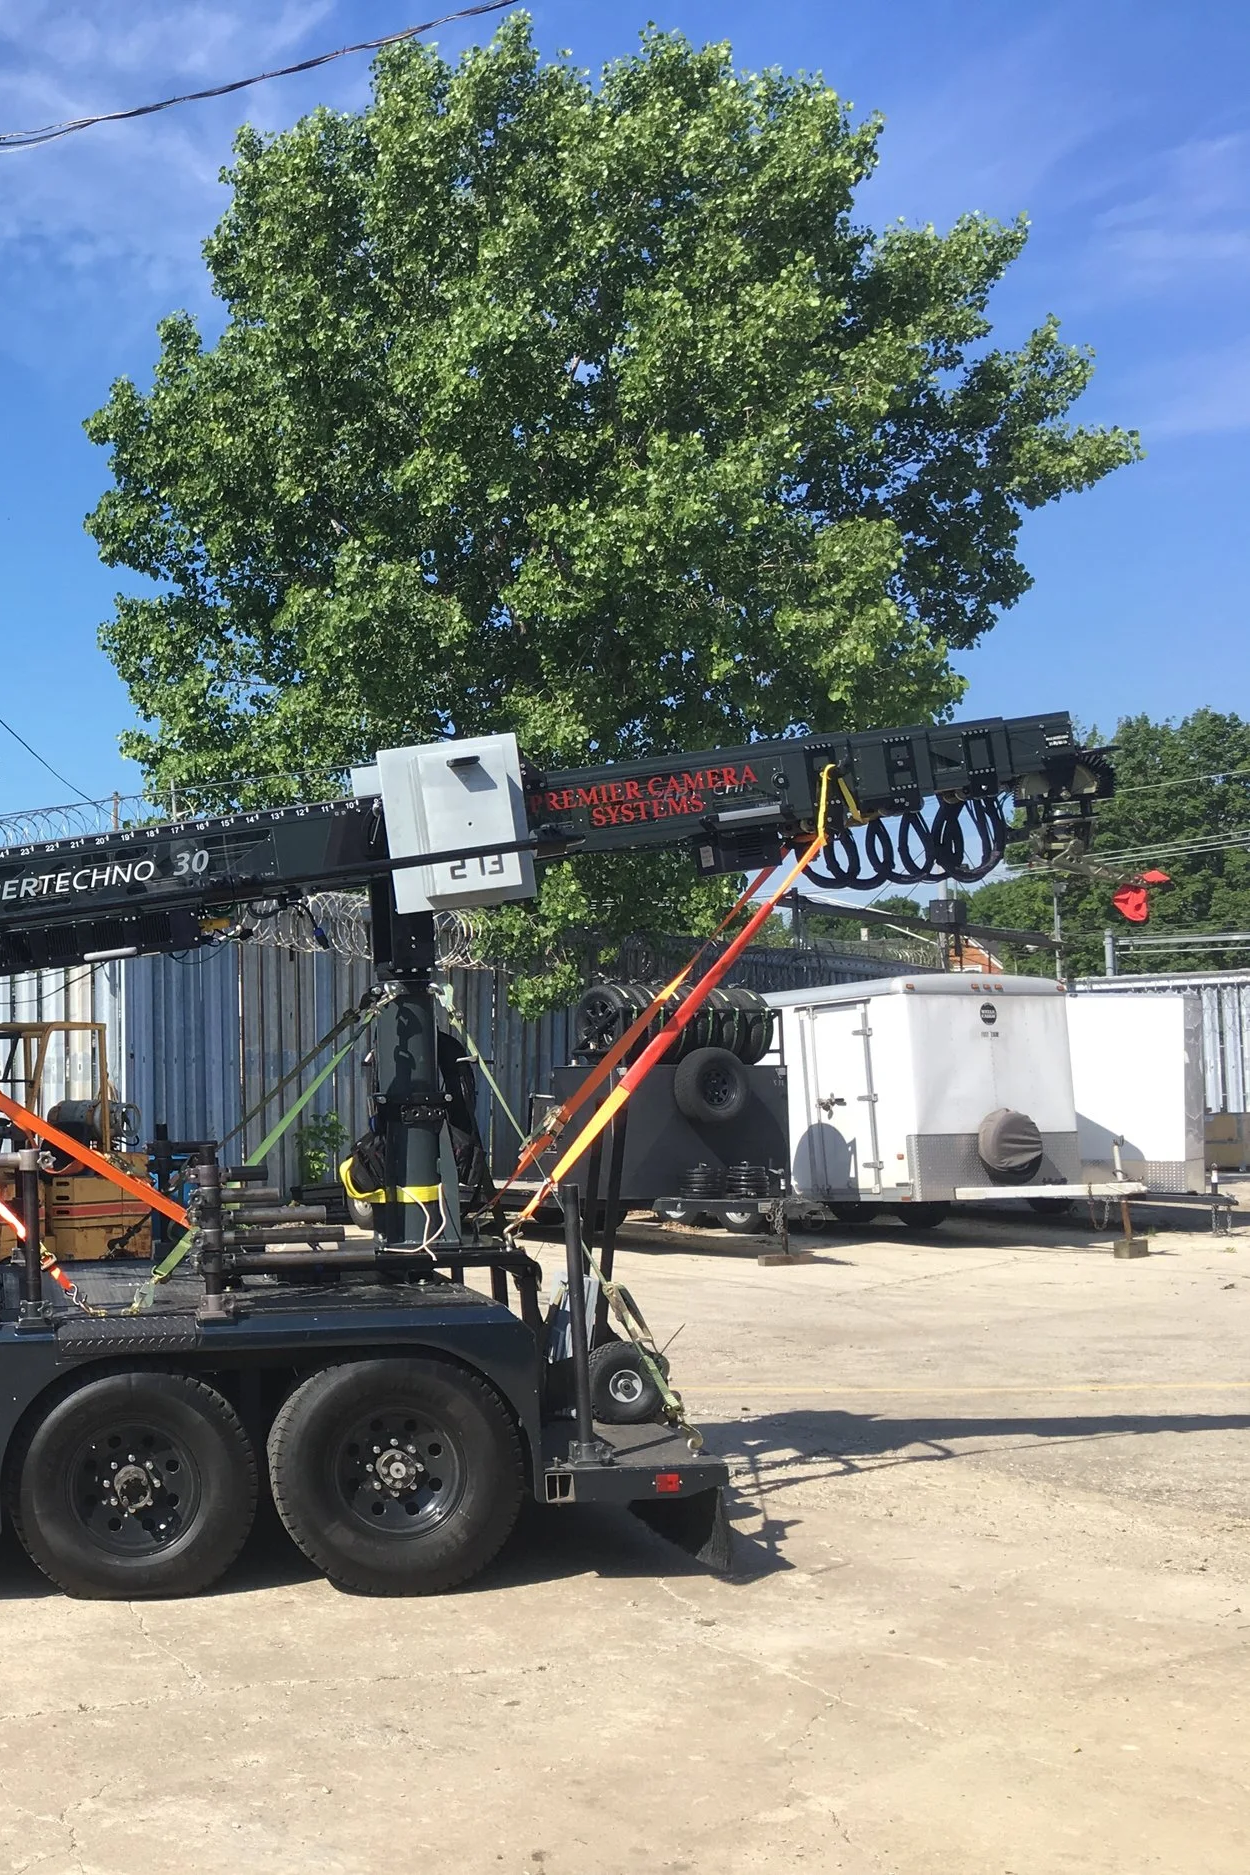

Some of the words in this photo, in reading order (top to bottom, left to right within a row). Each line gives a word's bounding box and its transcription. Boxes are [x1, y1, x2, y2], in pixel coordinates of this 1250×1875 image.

[530, 780, 642, 813] PREMIER
[647, 765, 758, 795] CAMERA
[592, 794, 706, 827] SYSTEMS
[173, 849, 209, 876] 30
